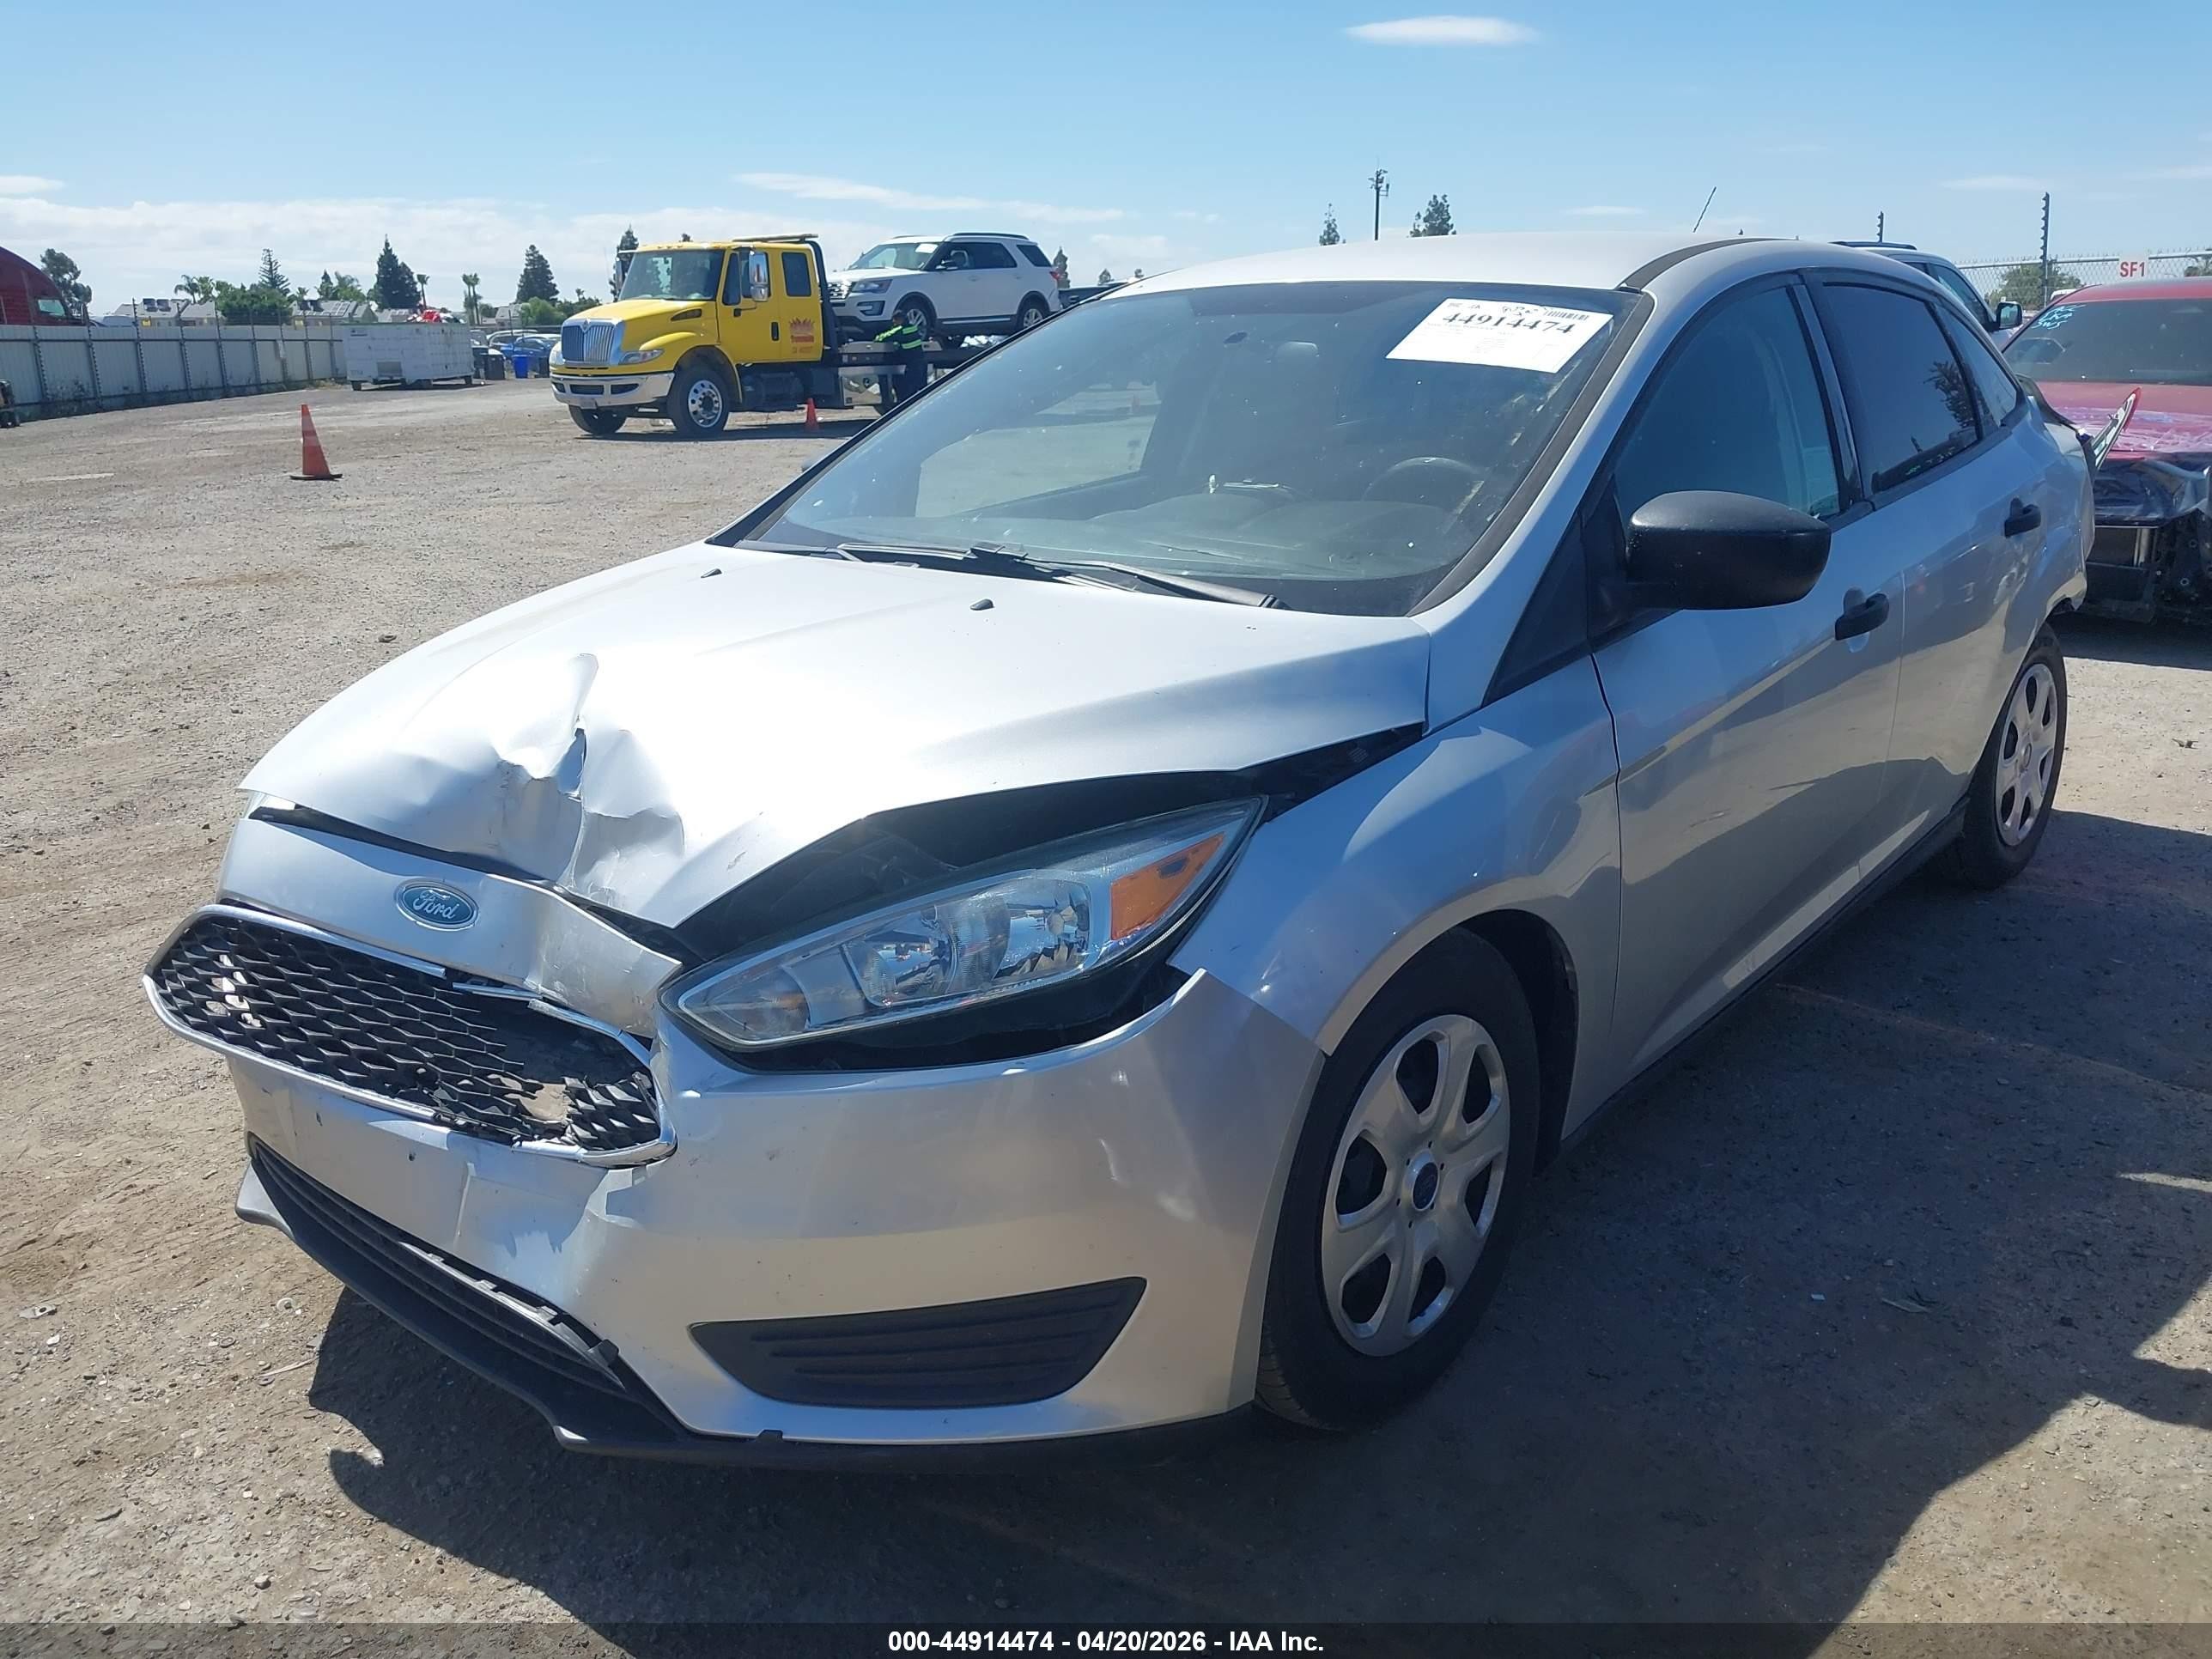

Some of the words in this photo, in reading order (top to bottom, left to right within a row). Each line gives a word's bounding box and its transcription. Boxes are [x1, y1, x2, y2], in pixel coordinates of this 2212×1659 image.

[2119, 261, 2145, 277] SF1
[1443, 312, 1577, 334] 44914474
[412, 890, 460, 920] Ford
